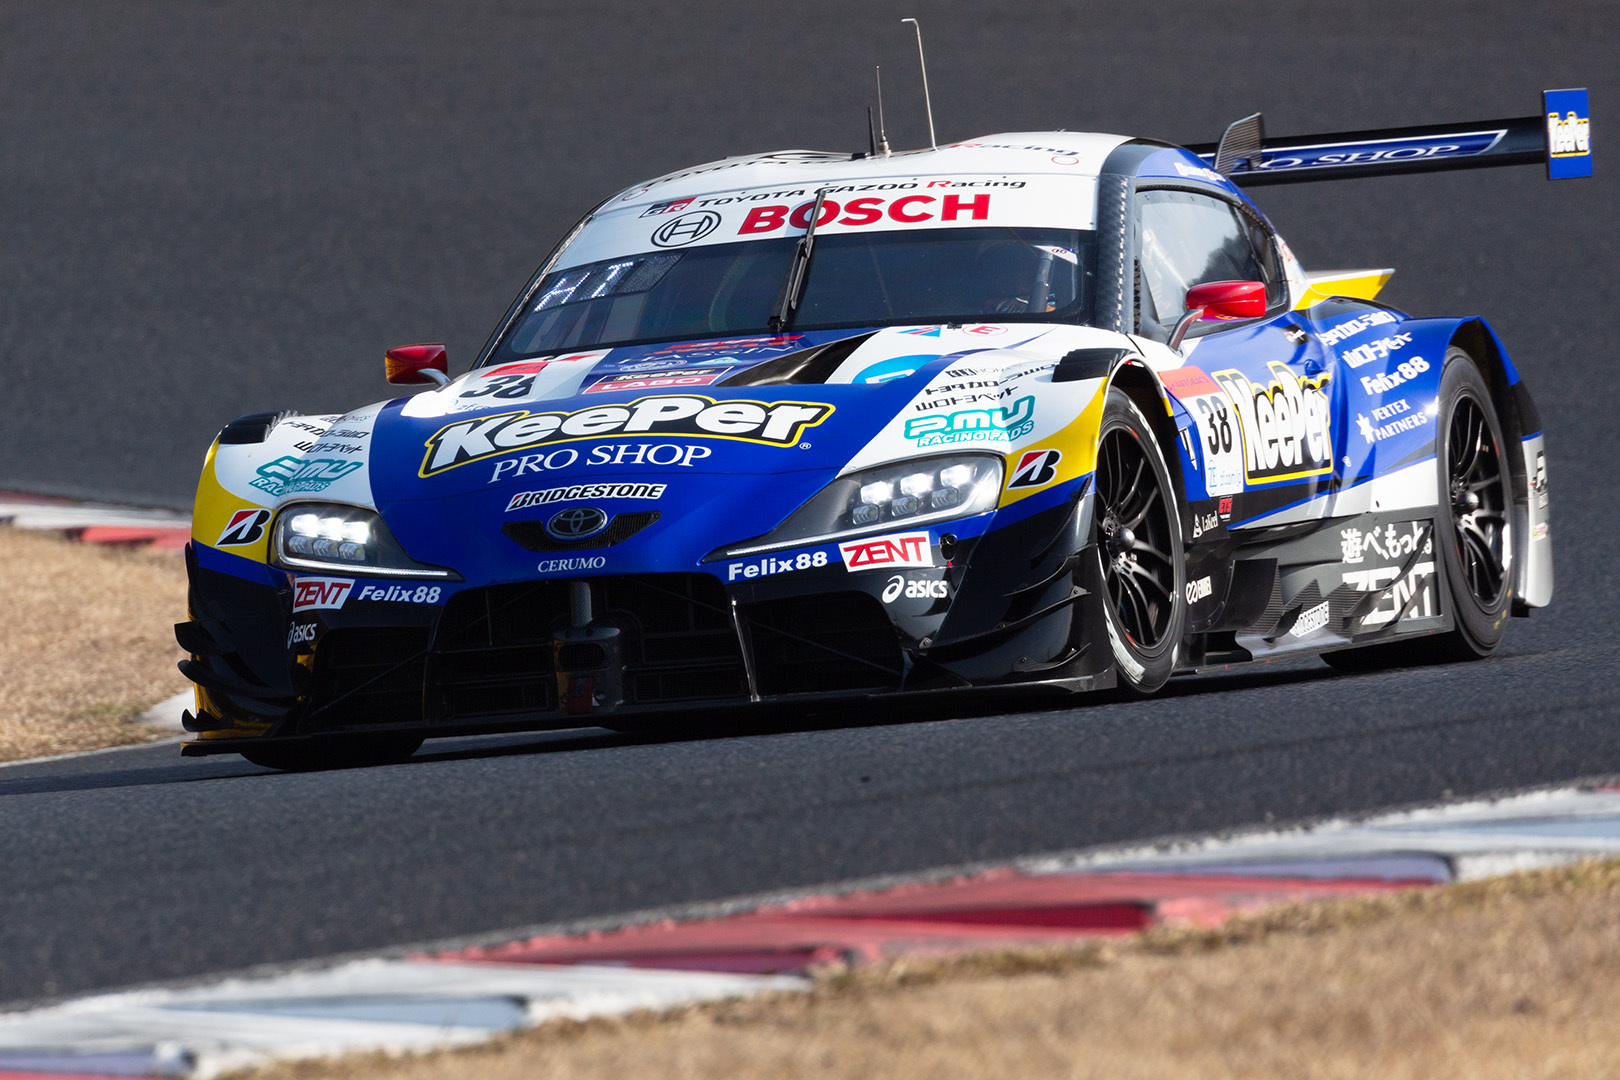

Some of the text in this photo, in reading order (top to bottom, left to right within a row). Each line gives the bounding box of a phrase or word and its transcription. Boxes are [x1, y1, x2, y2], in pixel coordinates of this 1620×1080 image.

[1311, 145, 1460, 166] SHOP
[699, 179, 1027, 207] TOYOTA GAZOO Racing
[737, 193, 991, 235] BOSCH
[458, 374, 538, 399] 38
[601, 377, 701, 391] LABO
[1360, 356, 1430, 395] Felix88
[1216, 371, 1331, 472] KeePer
[1371, 399, 1411, 422] VERTEX
[418, 395, 836, 482] KeePer
[917, 420, 1034, 448] RACING PADS
[1196, 395, 1233, 456] 38
[1374, 411, 1428, 441] PARTNERS
[487, 444, 712, 484] PRO SHOP
[504, 483, 668, 512] BRIDGESTONE
[537, 556, 606, 573] CERUMO
[728, 551, 828, 581] Felix88
[843, 536, 930, 568] ZENT
[296, 580, 352, 610] ZENT
[358, 585, 442, 604] Felix88
[904, 579, 948, 599] asics
